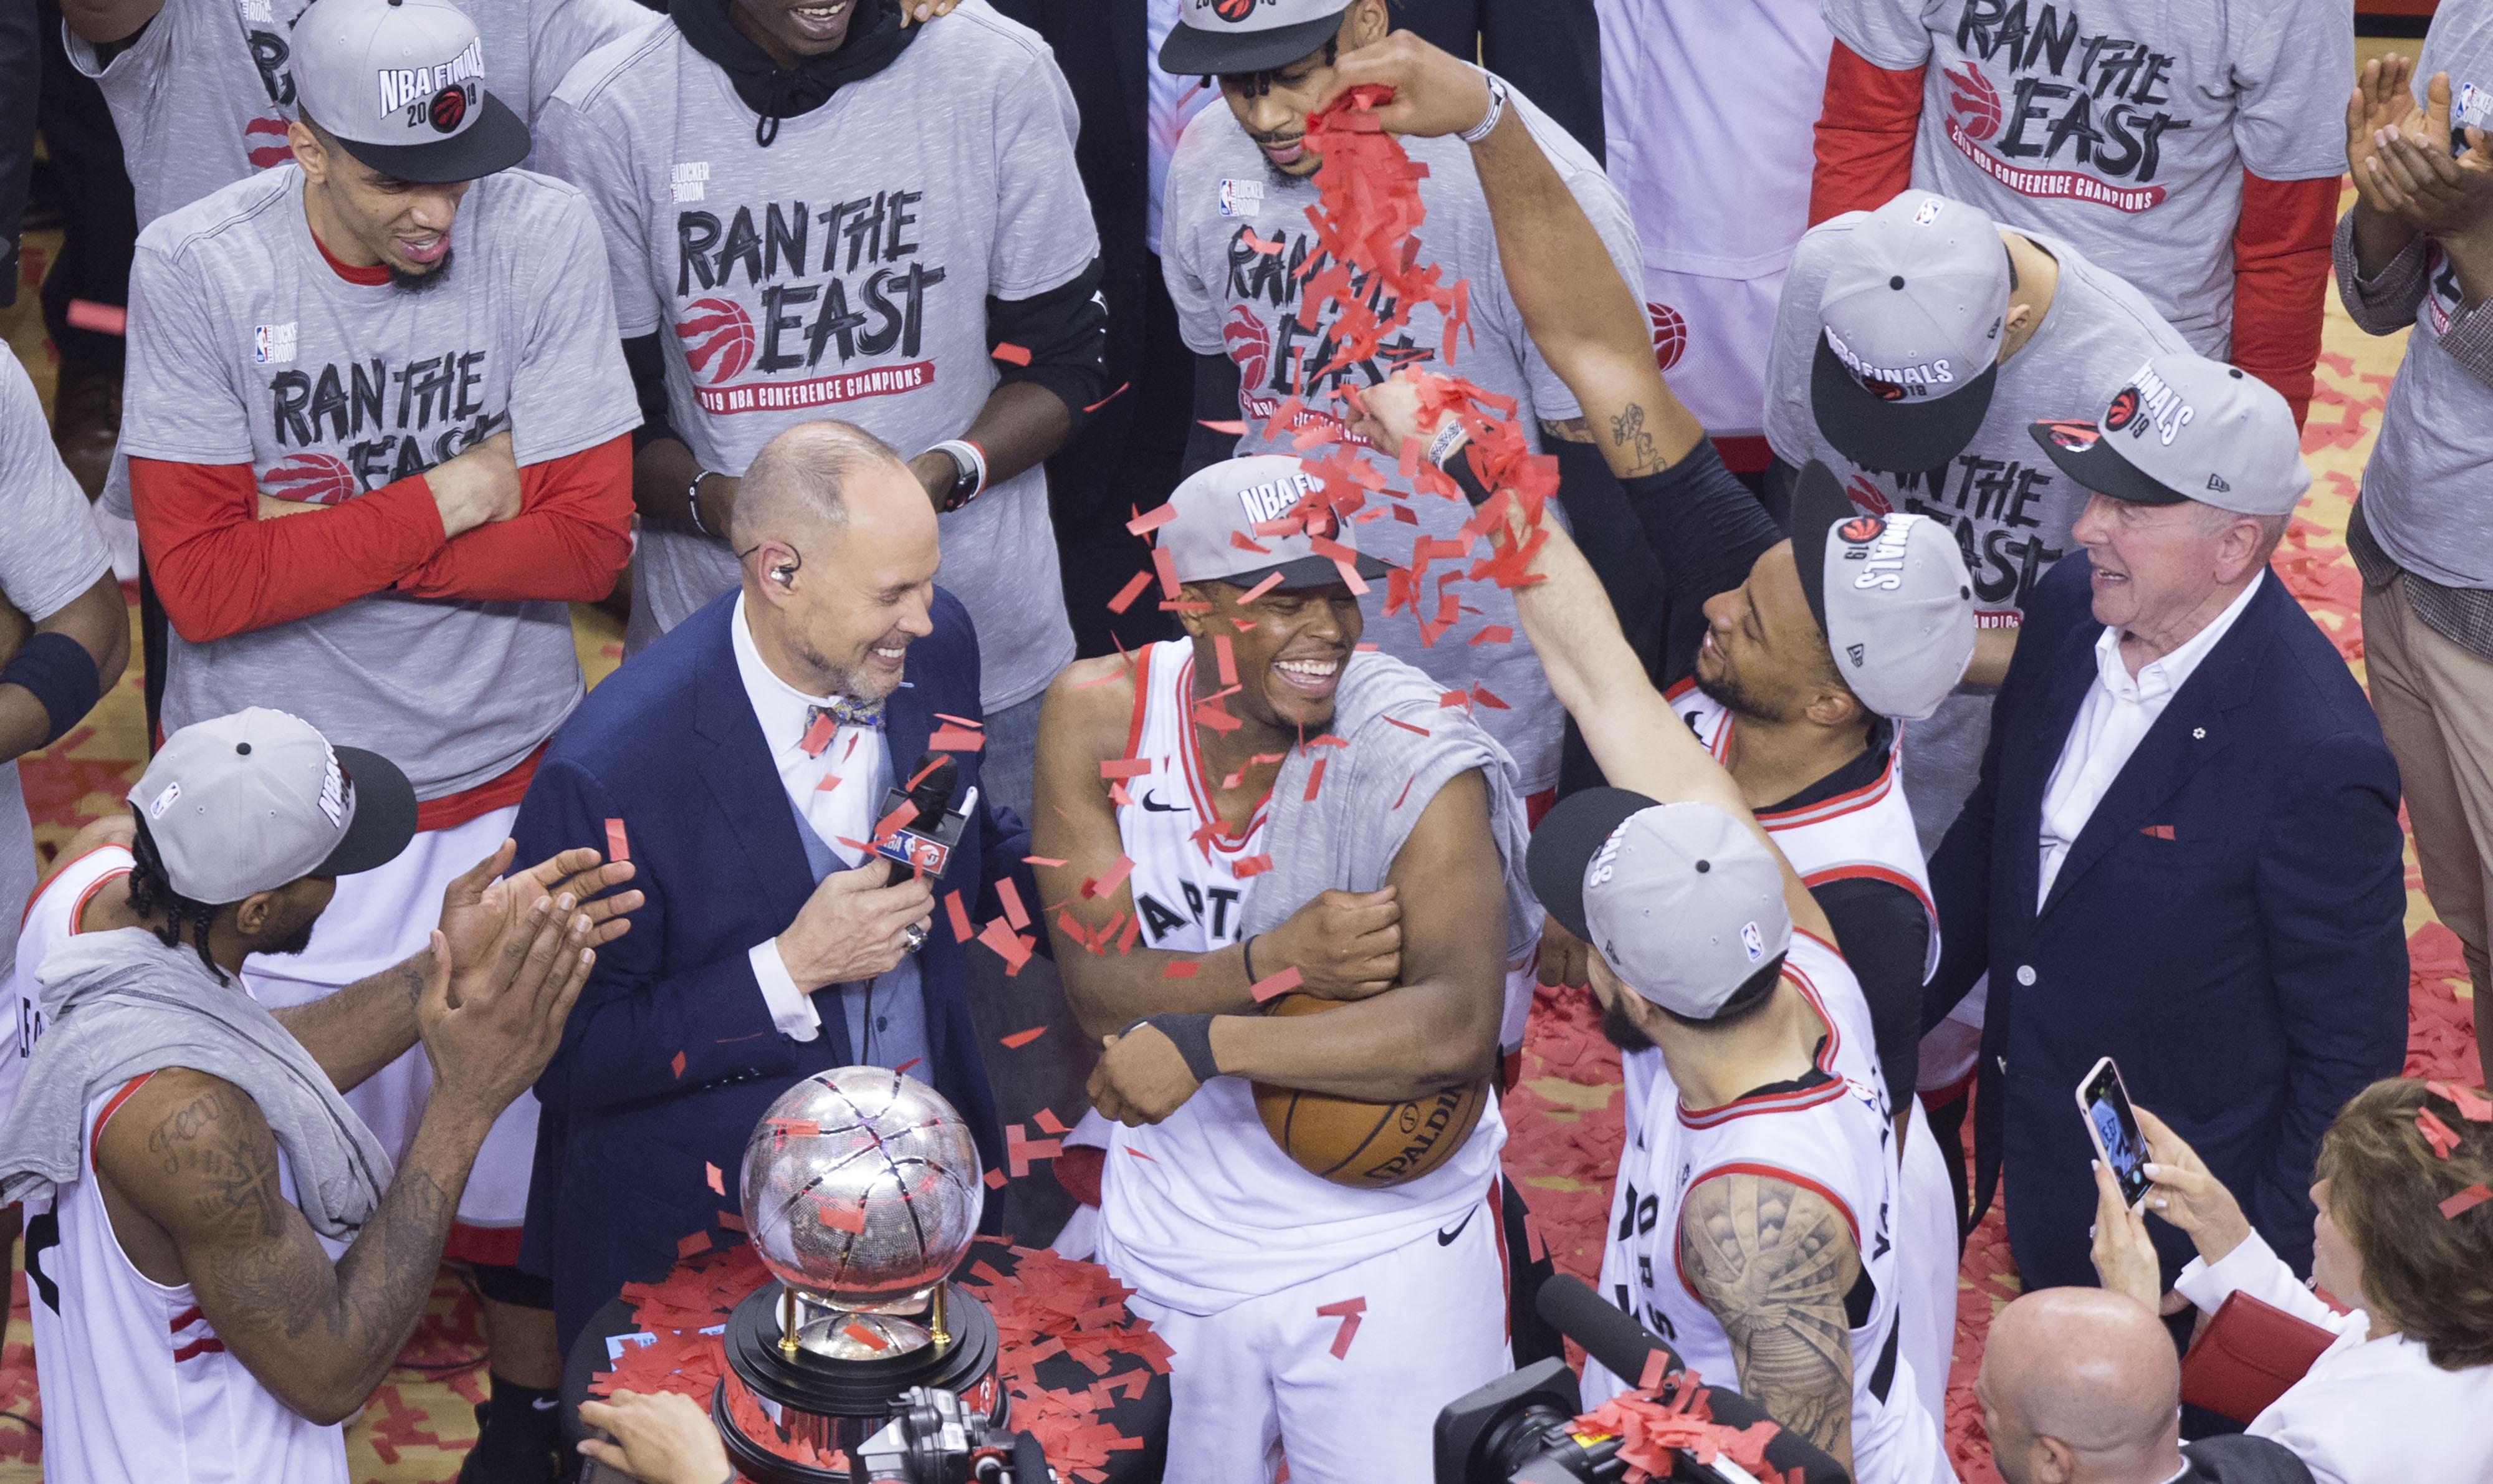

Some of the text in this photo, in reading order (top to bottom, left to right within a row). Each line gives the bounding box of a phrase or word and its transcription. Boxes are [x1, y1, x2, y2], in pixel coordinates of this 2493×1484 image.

[1956, 0, 2176, 105] RAN THE
[378, 69, 433, 120] NBA
[407, 83, 477, 128] 20 19
[1994, 77, 2192, 183] EAST
[676, 161, 709, 183] LOCKER
[677, 181, 704, 202] ROOM
[1973, 148, 1992, 173] NBA
[1995, 163, 2071, 194] CONFERENCE
[2075, 177, 2153, 210] CHAMPIONS
[677, 189, 923, 297] RAN THE
[752, 261, 947, 377] EAST
[269, 350, 486, 448] RAN THE
[701, 367, 922, 411] 019 NBA CONFERENCE CHAMPIONS
[1861, 358, 1955, 385] FINALS
[2129, 412, 2150, 439] 19
[1238, 477, 1297, 541] NBA
[1959, 455, 2053, 528] THE
[1844, 544, 1870, 560] 19
